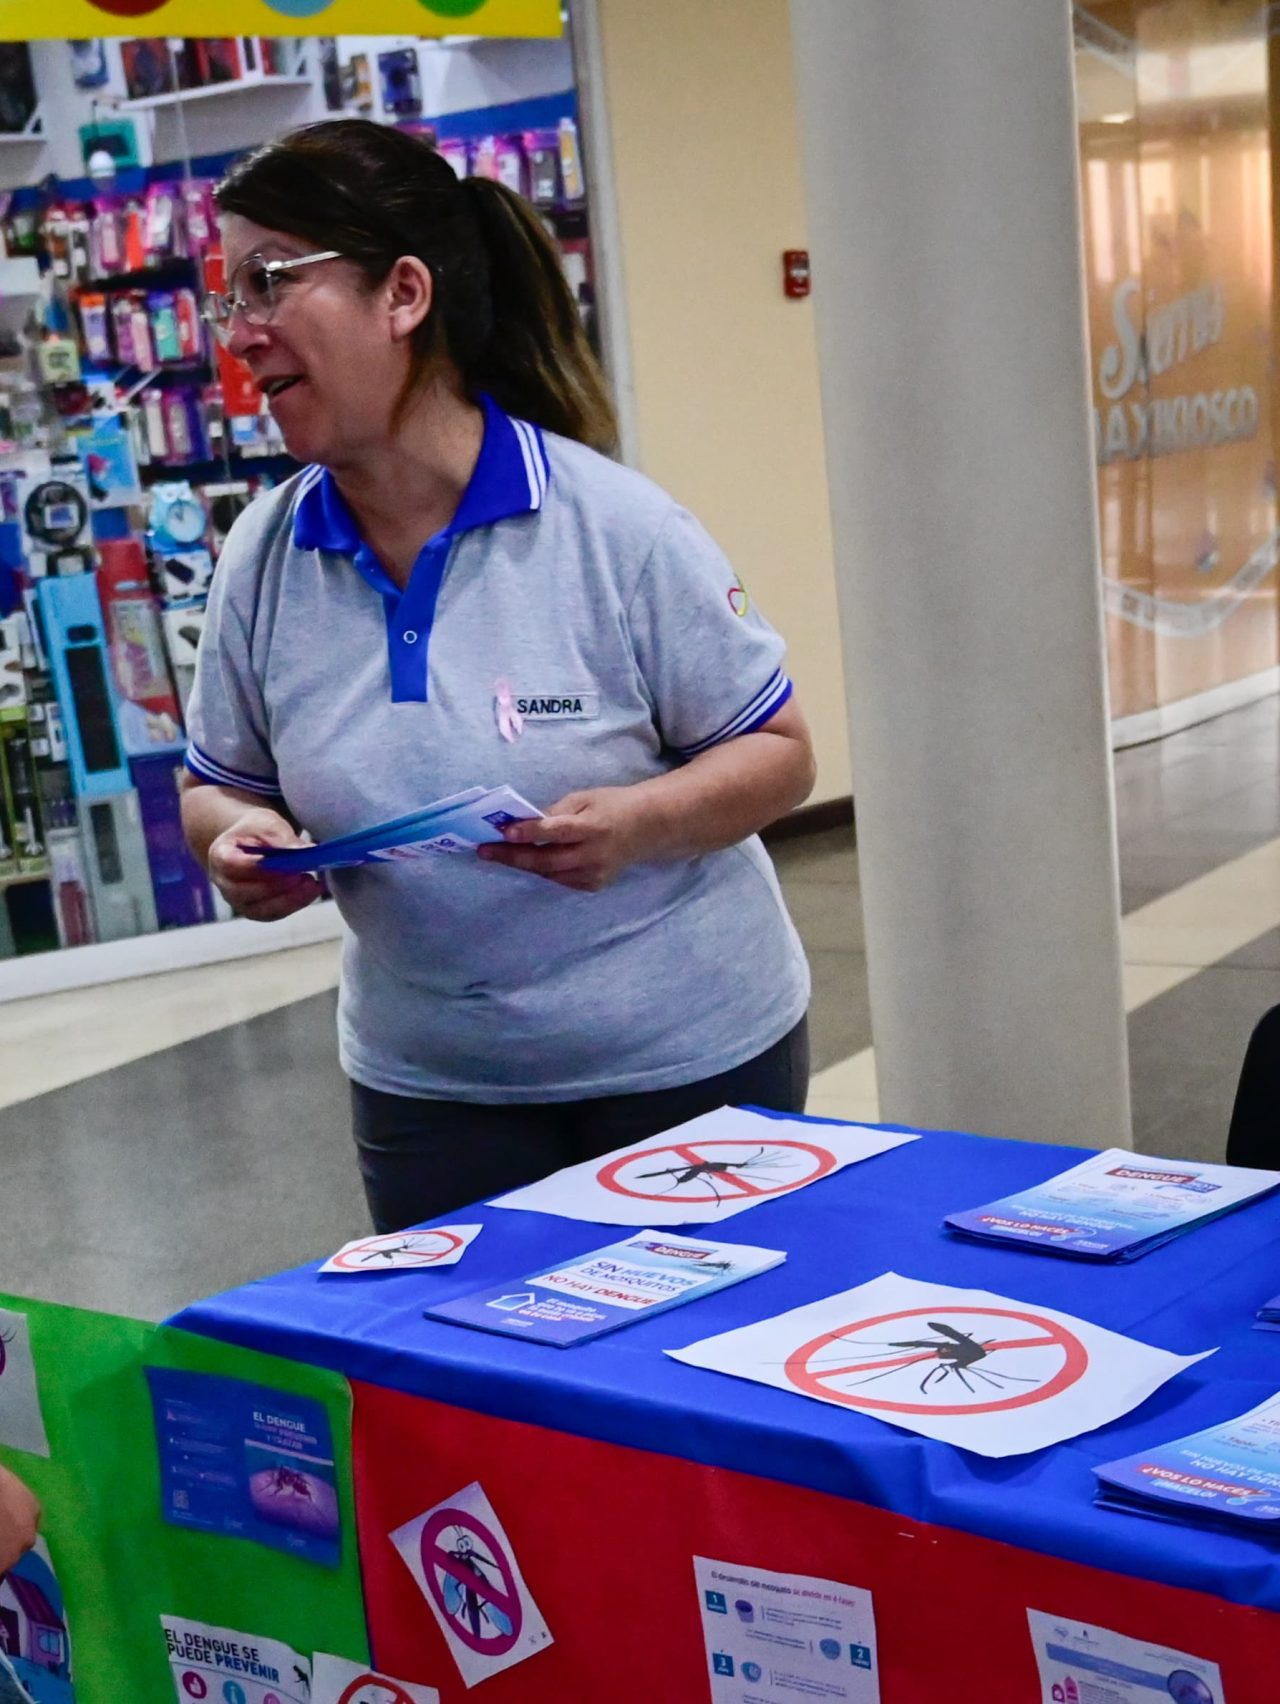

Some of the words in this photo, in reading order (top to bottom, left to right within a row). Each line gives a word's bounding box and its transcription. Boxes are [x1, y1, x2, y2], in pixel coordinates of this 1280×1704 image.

[516, 698, 583, 715] SANDRA
[1115, 1168, 1188, 1183] DENGUE
[592, 1260, 619, 1274] SIN
[542, 1274, 567, 1284] NO
[566, 1278, 596, 1292] HAY
[594, 1287, 658, 1305] DENGUE
[266, 1414, 307, 1434] DENGUE
[164, 1628, 182, 1645] EL
[184, 1632, 240, 1660] DENGUE
[242, 1645, 261, 1663] SE
[167, 1643, 213, 1665] PUEDE
[215, 1652, 280, 1684] PREVENIR
